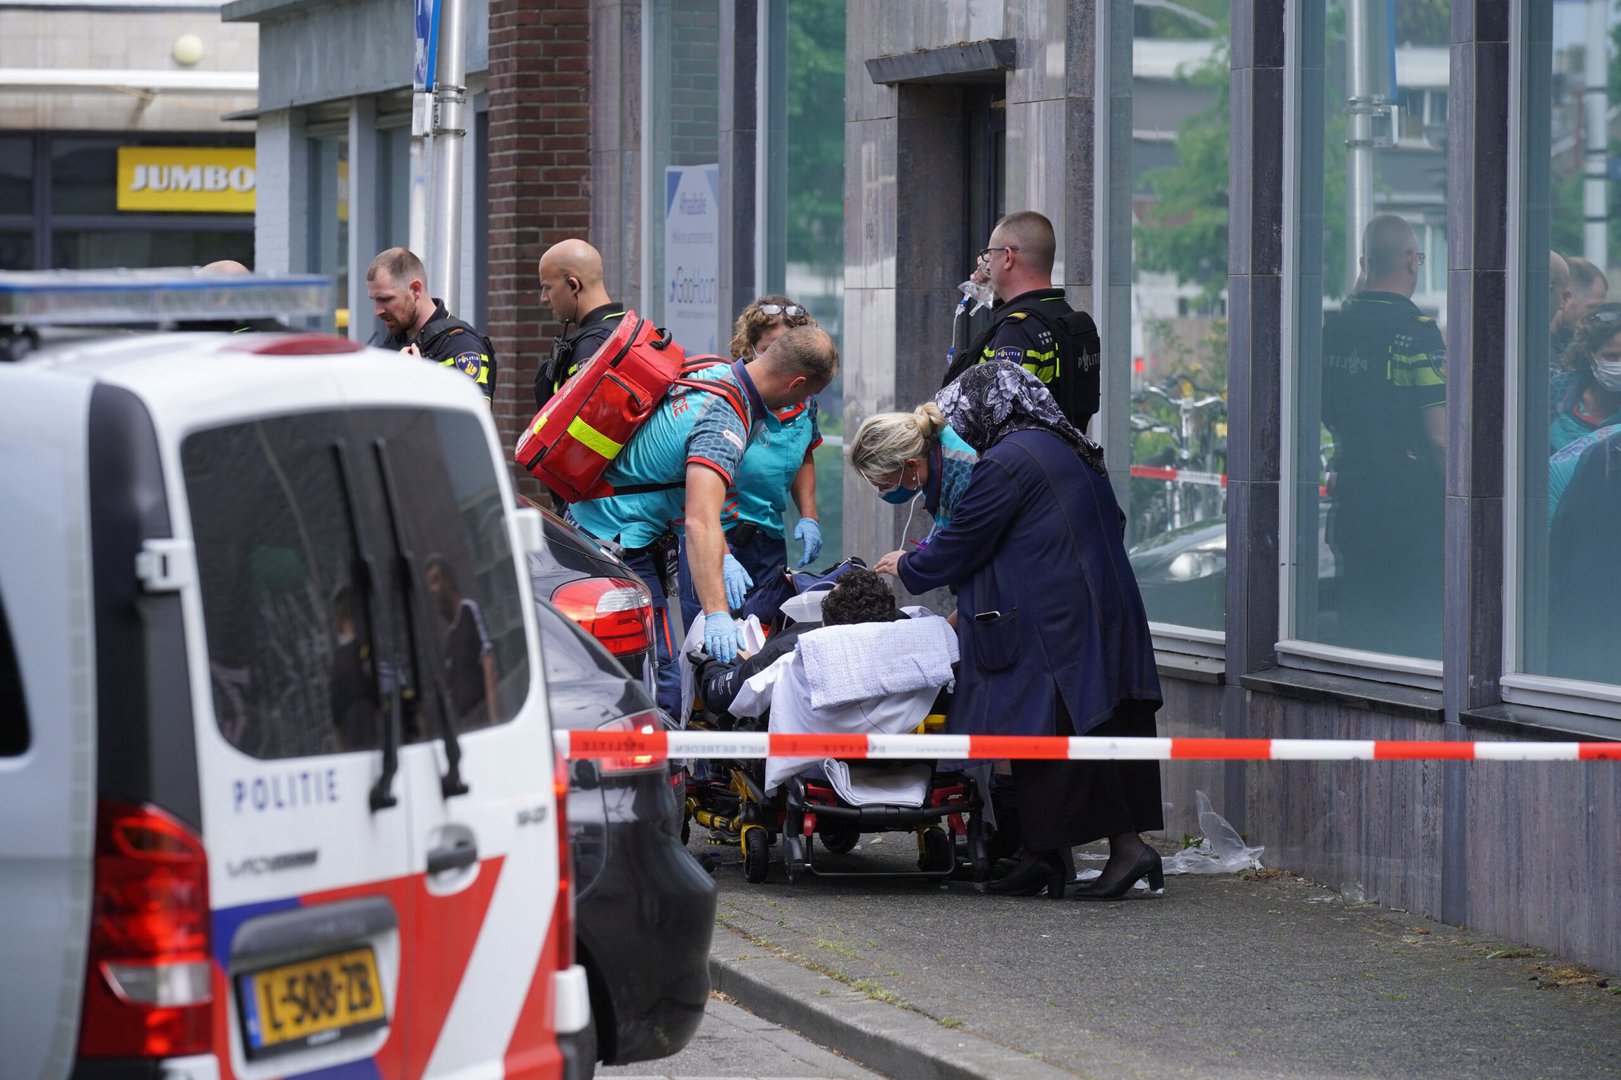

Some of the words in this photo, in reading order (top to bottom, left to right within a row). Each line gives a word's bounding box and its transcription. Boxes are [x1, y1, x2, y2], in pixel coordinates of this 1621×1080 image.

[128, 164, 256, 193] JUMBO
[997, 348, 1021, 358] POLITIE
[233, 768, 338, 815] POLITIE
[264, 961, 374, 1031] L-508-ZB
